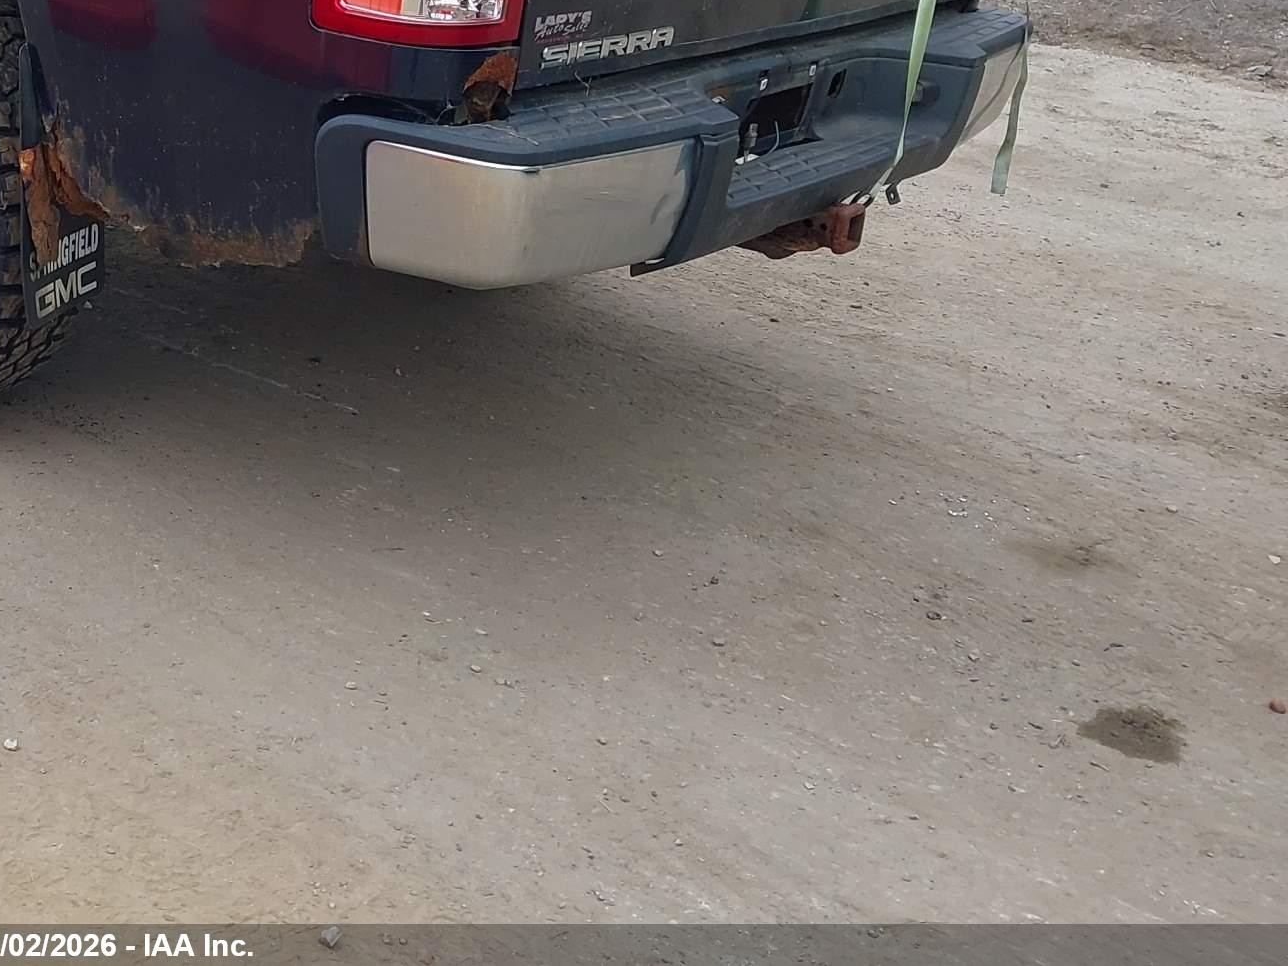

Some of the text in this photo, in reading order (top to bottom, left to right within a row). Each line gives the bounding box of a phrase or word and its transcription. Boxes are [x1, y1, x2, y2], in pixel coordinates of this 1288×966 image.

[534, 11, 592, 33] LADY'S
[541, 25, 674, 70] SIERRA
[29, 223, 99, 282] SNGFIELD
[35, 261, 97, 319] GMC
